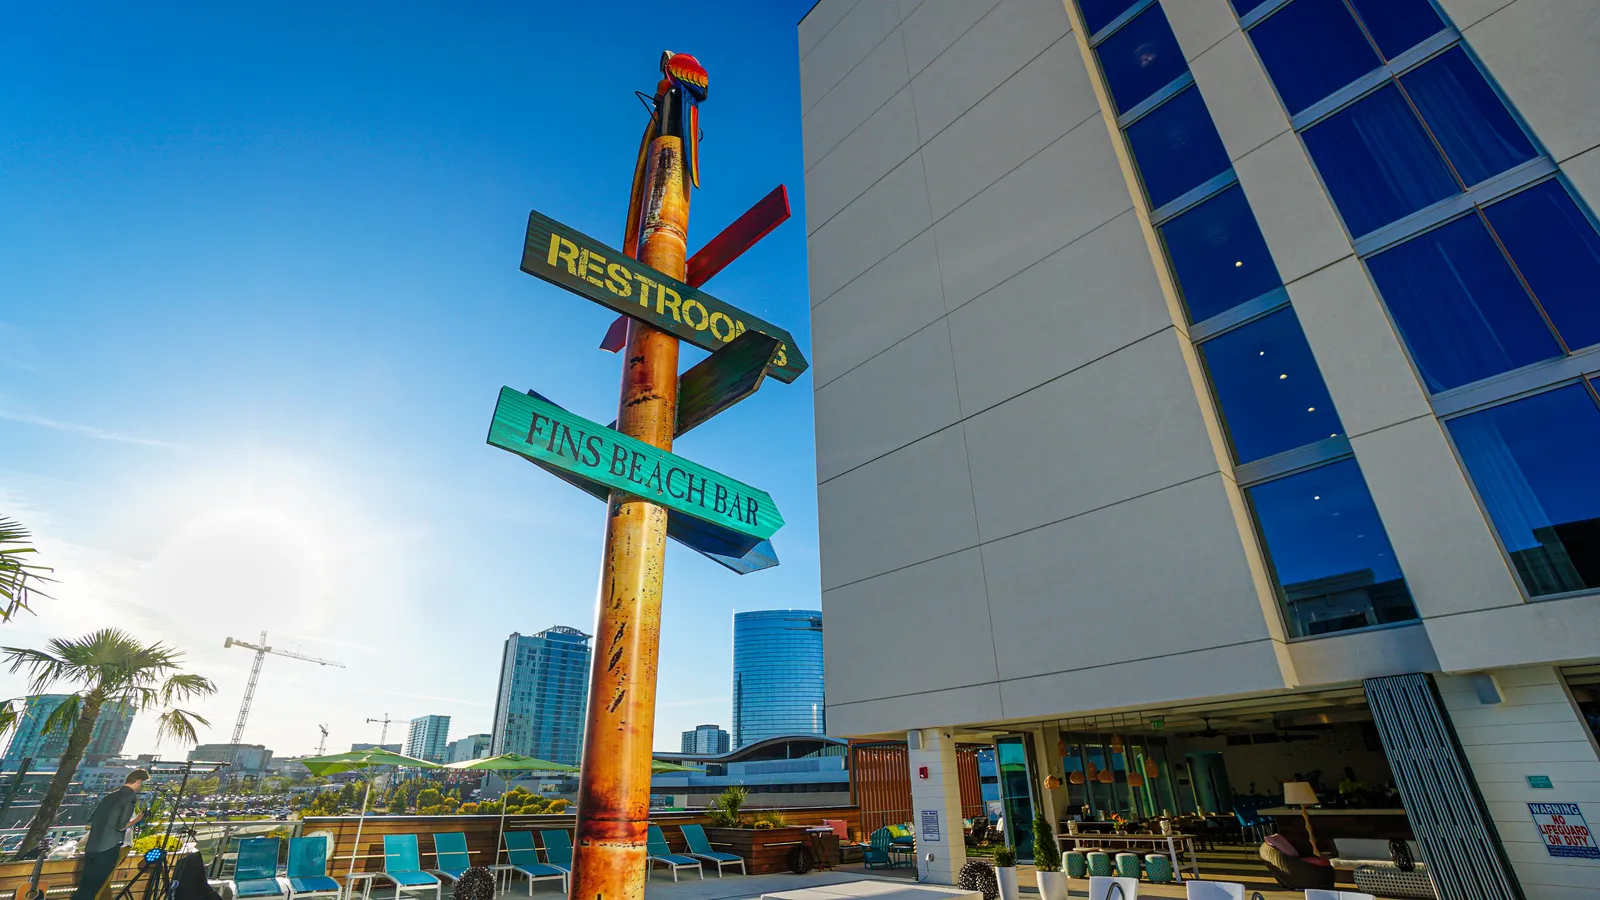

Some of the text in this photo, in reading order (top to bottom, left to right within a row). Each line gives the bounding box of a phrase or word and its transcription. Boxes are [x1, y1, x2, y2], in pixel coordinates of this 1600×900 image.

[547, 233, 787, 367] RESTROOS
[525, 411, 759, 527] FINS BEACH BAR
[1529, 804, 1580, 815] WARNING
[1551, 814, 1566, 825] NO
[1539, 824, 1589, 837] LIFEGUARD
[1548, 835, 1589, 847] ON DUTY
